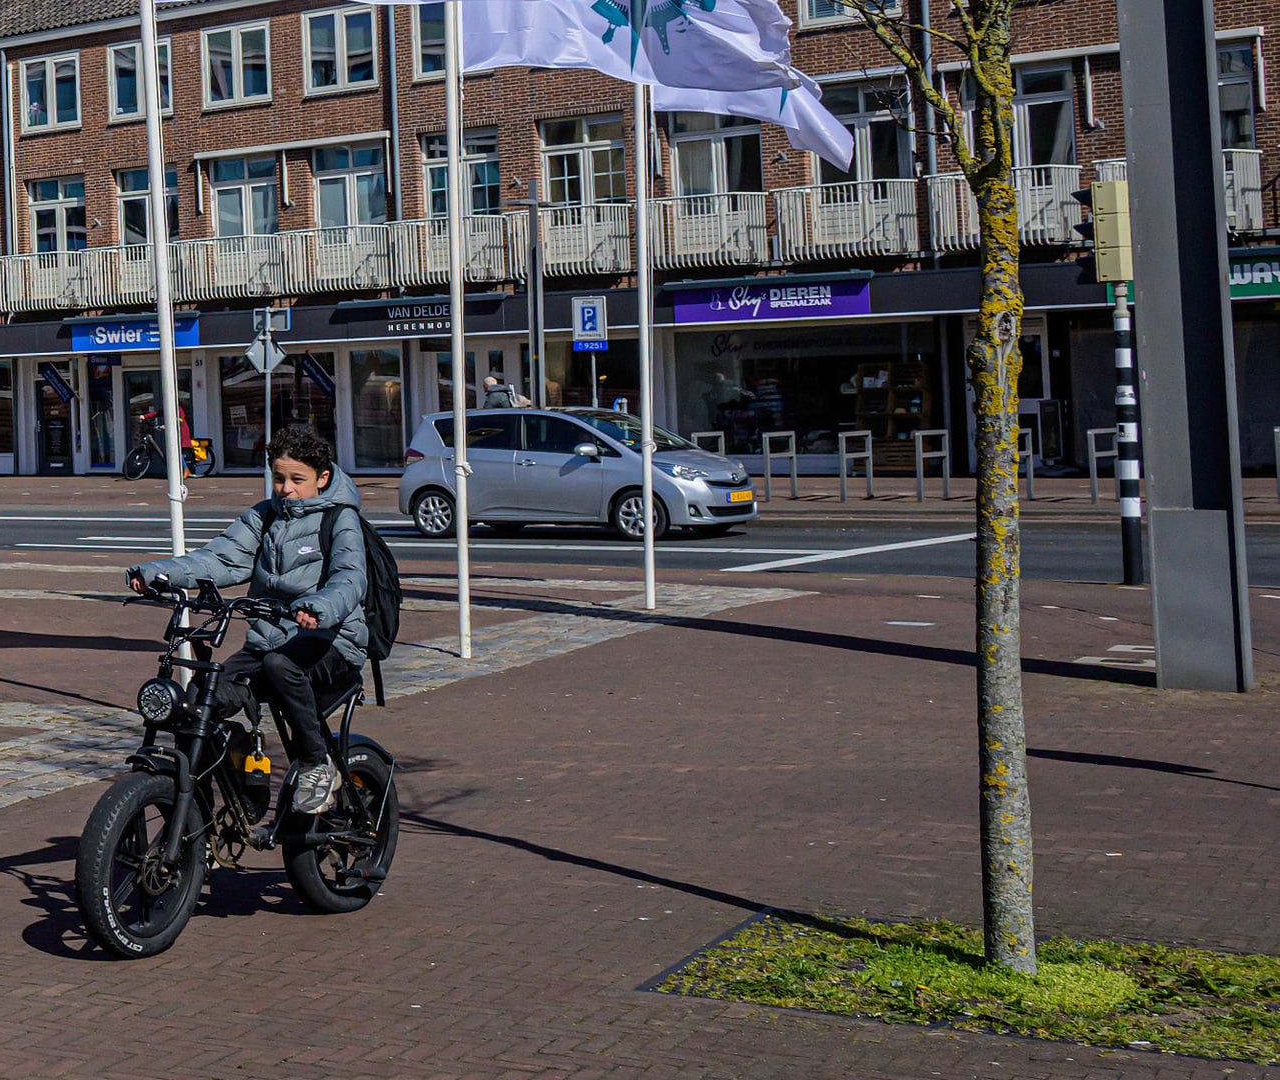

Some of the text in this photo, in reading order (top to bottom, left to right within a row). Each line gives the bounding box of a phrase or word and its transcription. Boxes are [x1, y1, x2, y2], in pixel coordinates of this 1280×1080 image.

[769, 285, 832, 300] DIEREN
[769, 298, 832, 308] SPECIAALZAAK
[387, 304, 450, 319] VAN DELDE
[584, 308, 594, 321] P
[387, 321, 451, 332] HERENMOD
[94, 326, 144, 345] Swier
